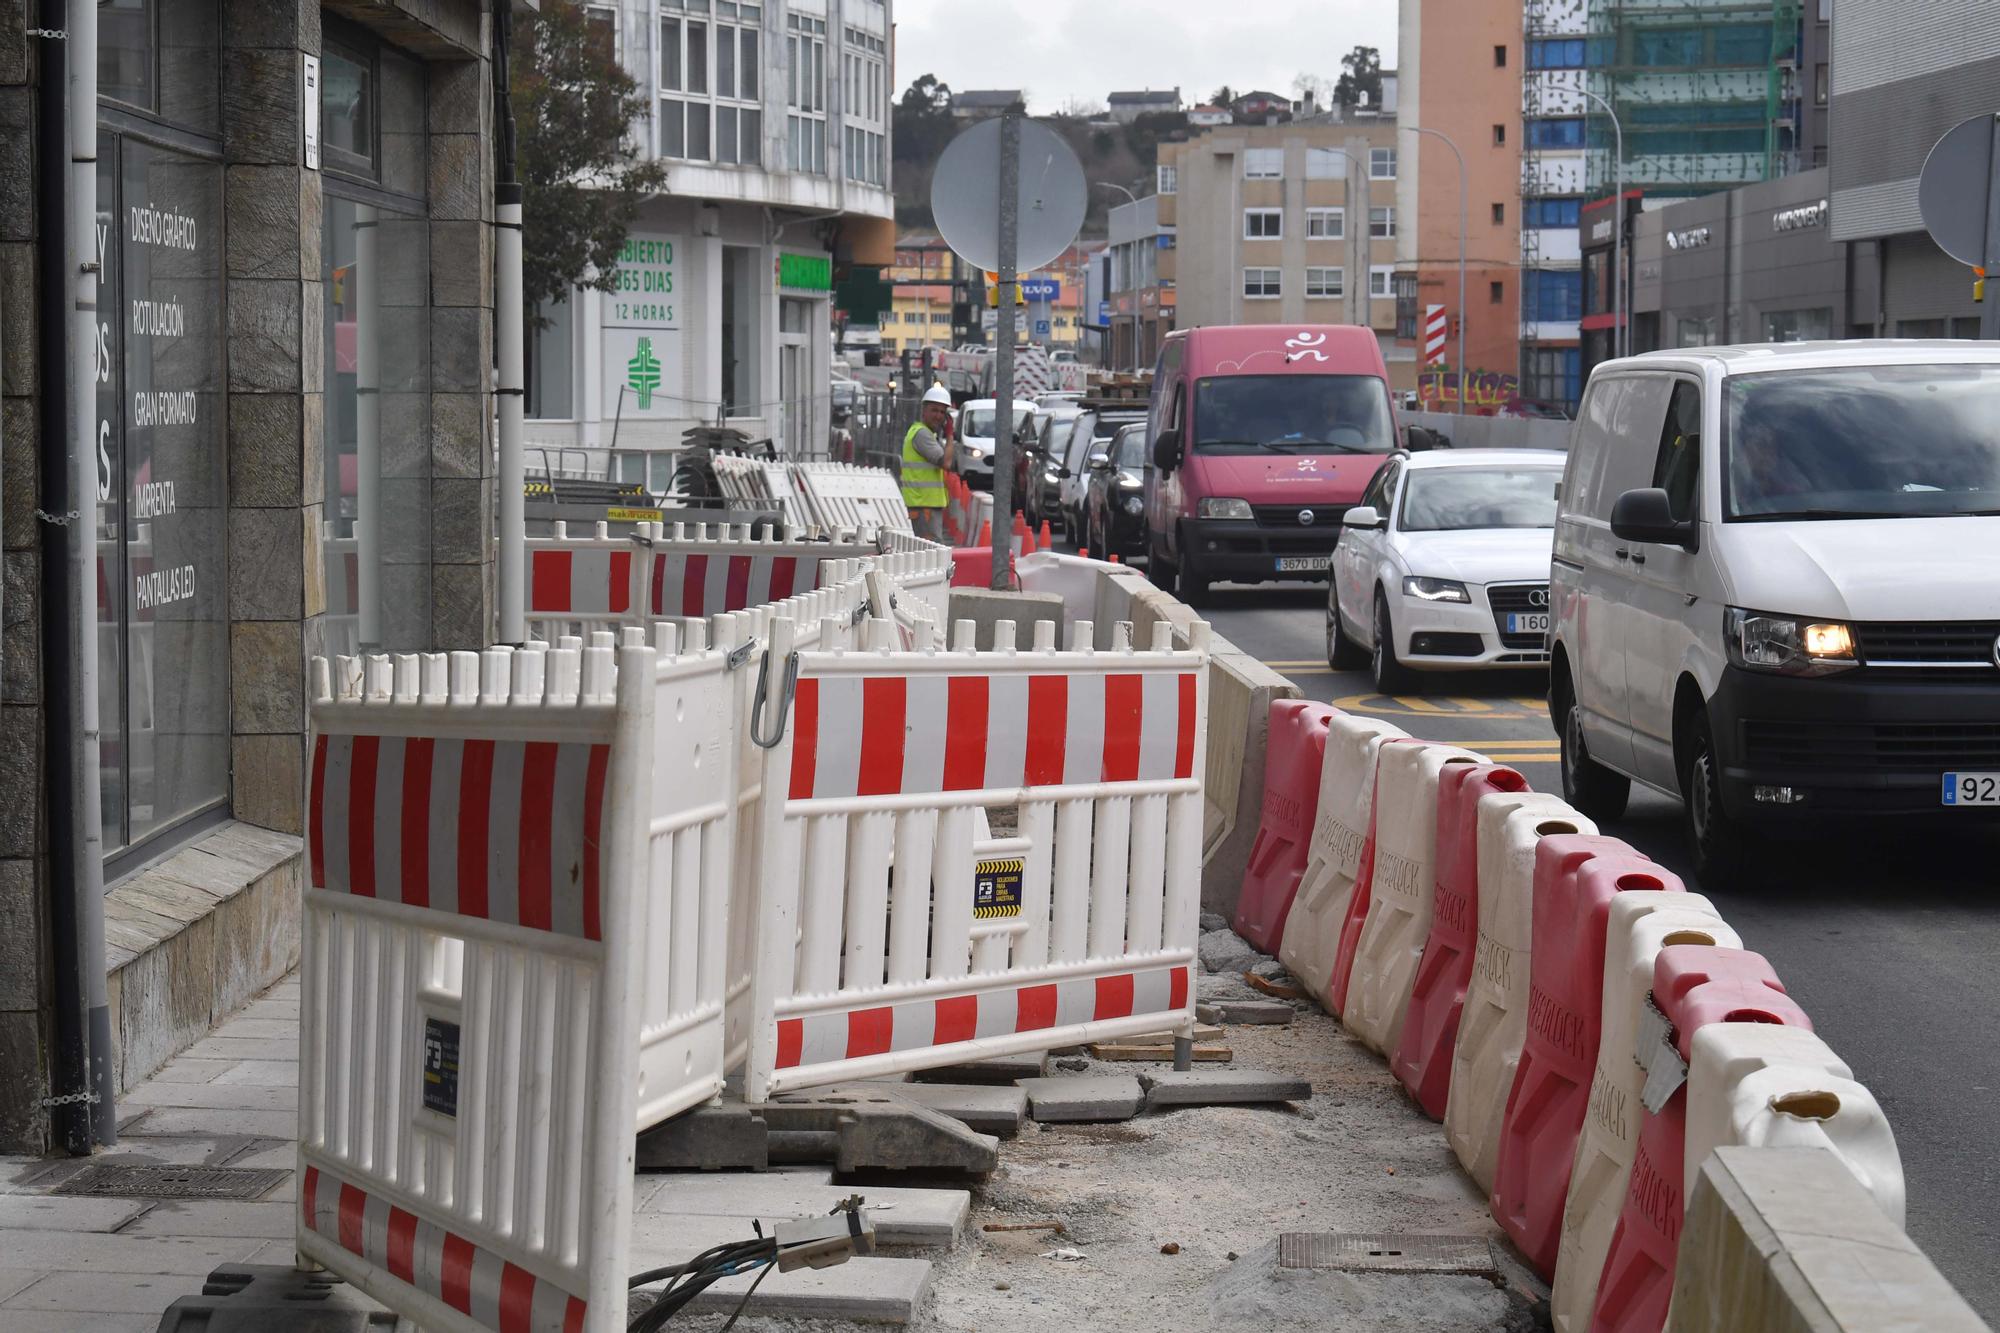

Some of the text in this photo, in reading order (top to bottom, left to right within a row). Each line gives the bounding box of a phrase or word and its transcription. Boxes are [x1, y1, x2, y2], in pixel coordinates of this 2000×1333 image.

[131, 202, 197, 251] DISEÑO GRÁFICO
[644, 270, 673, 293] DIAS
[1022, 285, 1053, 294] LVO
[133, 294, 184, 337] ROTULACIÓN
[615, 304, 673, 321] 12 HORAS
[134, 391, 197, 426] GRAN FORMATO
[96, 420, 111, 501] S
[135, 480, 176, 519] IMPRENTA
[136, 564, 195, 610] PANTALLAS LED
[1521, 615, 1549, 630] 160
[1961, 777, 2000, 801] 92
[978, 881, 993, 895] F3
[425, 1038, 442, 1069] F3
